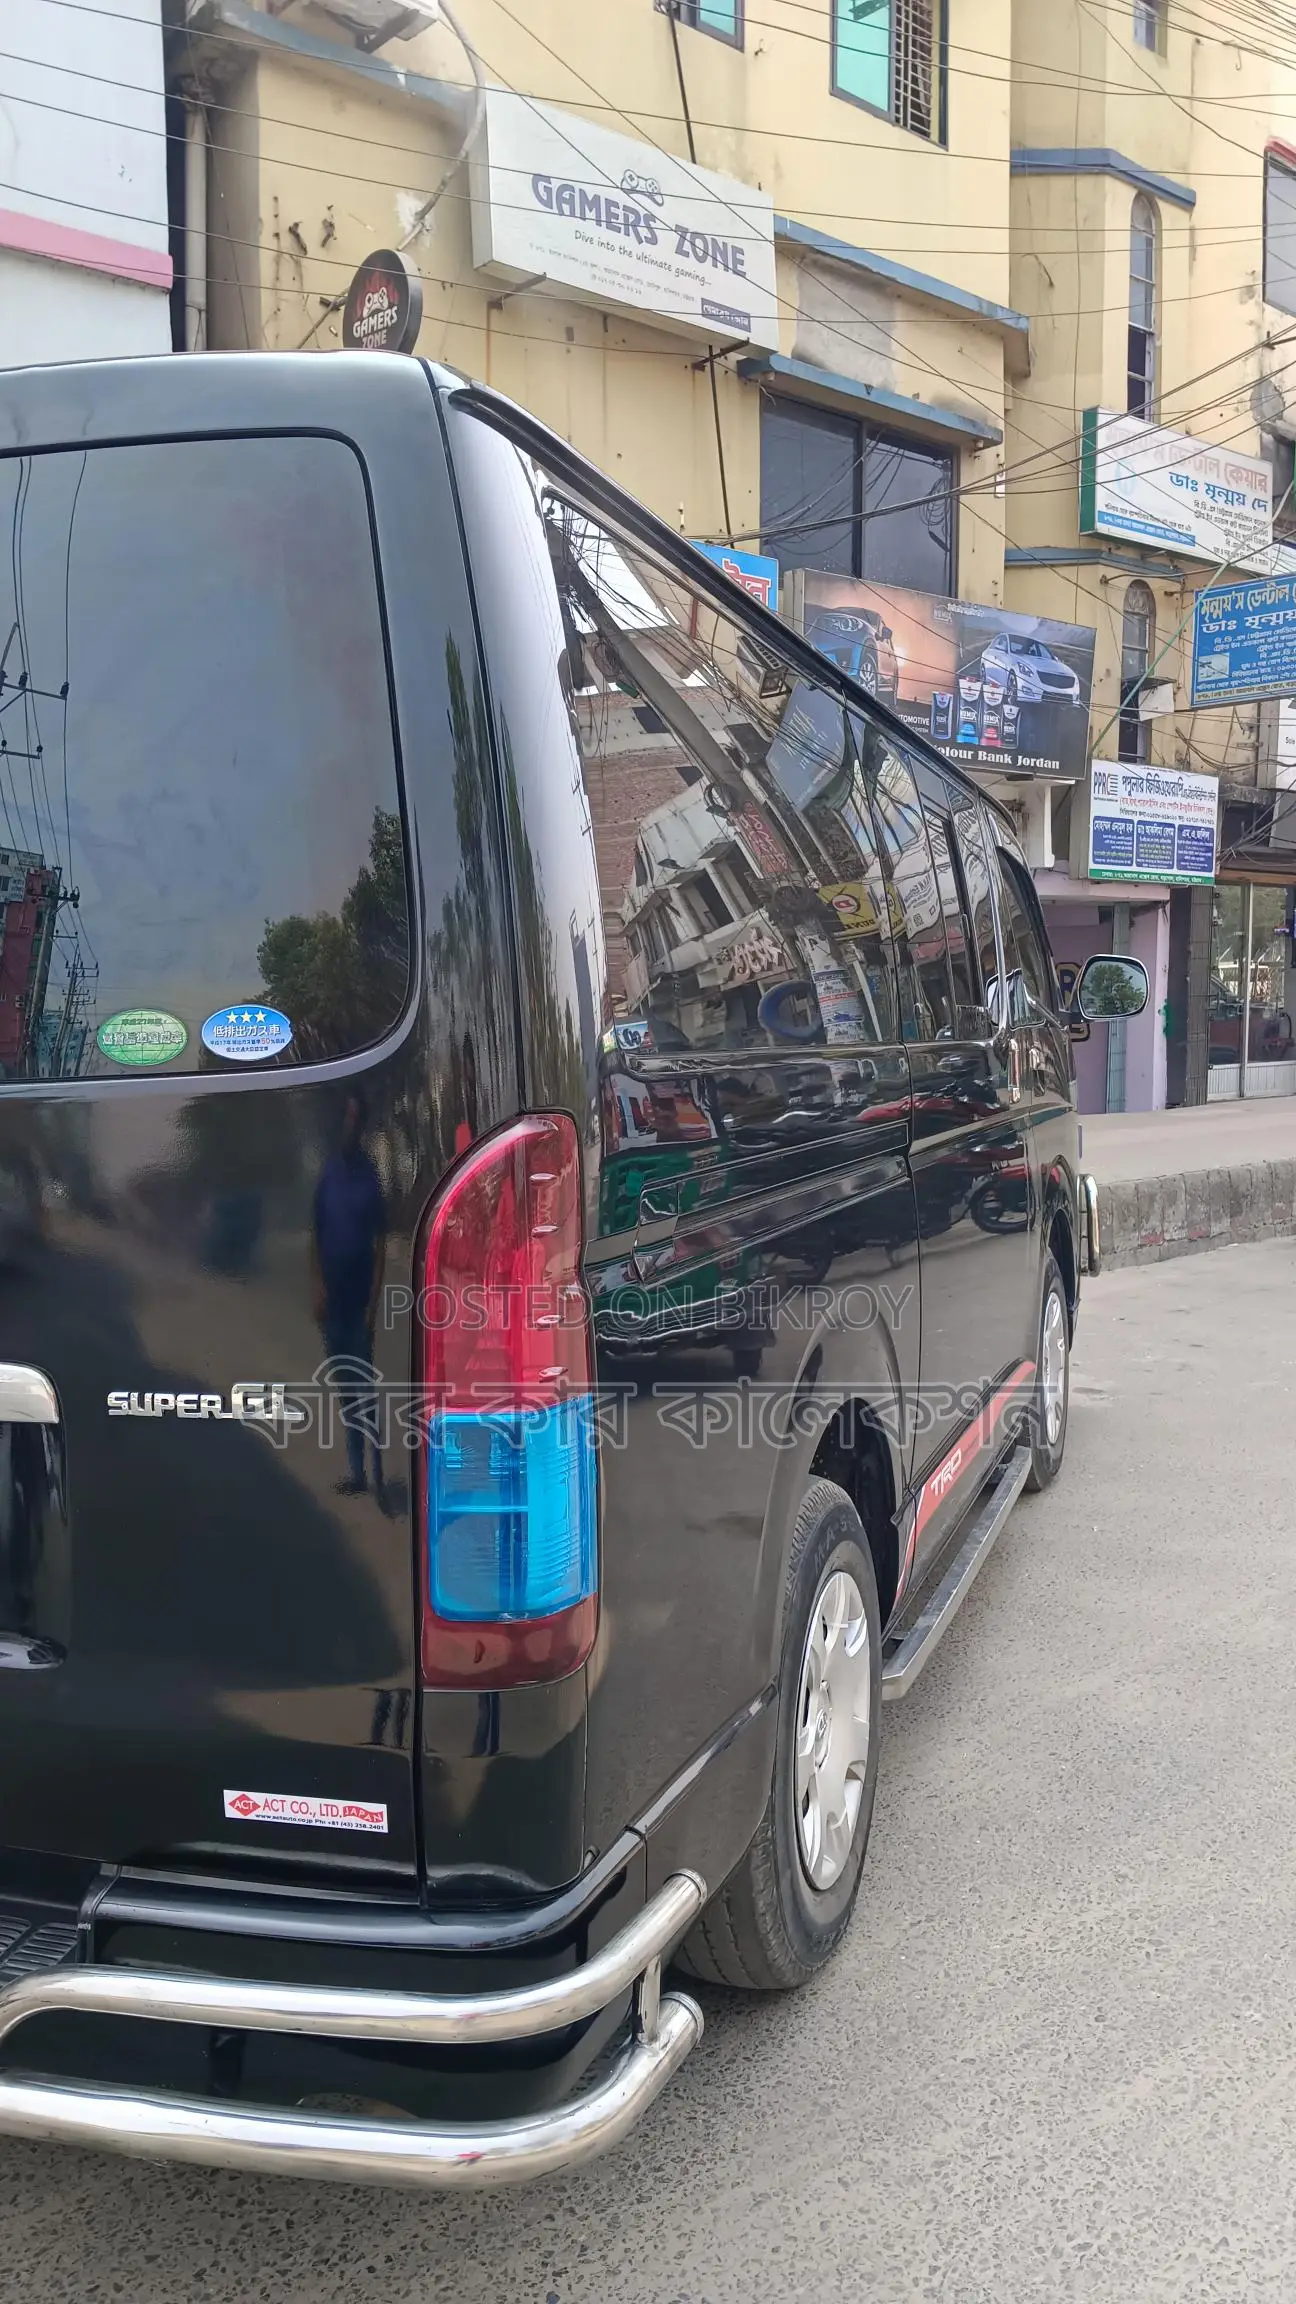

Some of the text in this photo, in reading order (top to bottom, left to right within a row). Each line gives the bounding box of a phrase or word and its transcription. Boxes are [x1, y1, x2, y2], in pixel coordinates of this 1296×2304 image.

[531, 173, 659, 246] GAMERS
[673, 223, 748, 277] ZONE
[574, 229, 594, 245] Dive
[597, 238, 616, 253] into
[618, 244, 633, 260] the
[635, 250, 673, 273] ultimate
[352, 305, 398, 348] GAMERS ZONE
[1168, 471, 1269, 512] ডাঃ মৃন্ময় দে
[1224, 461, 1268, 494] কেয়ার
[1247, 582, 1290, 611] ডেন্টাল
[1201, 619, 1238, 634] ডাঃ
[898, 713, 930, 726] TOMOTIVE
[934, 745, 1060, 770] olour Bank Jordan
[213, 1024, 281, 1038] 低排出ガス車
[107, 1383, 305, 1421] SUPER GL
[931, 1448, 961, 1497] TRD
[234, 1798, 383, 1823] ACT ACT CO., LTD. JAPAN
